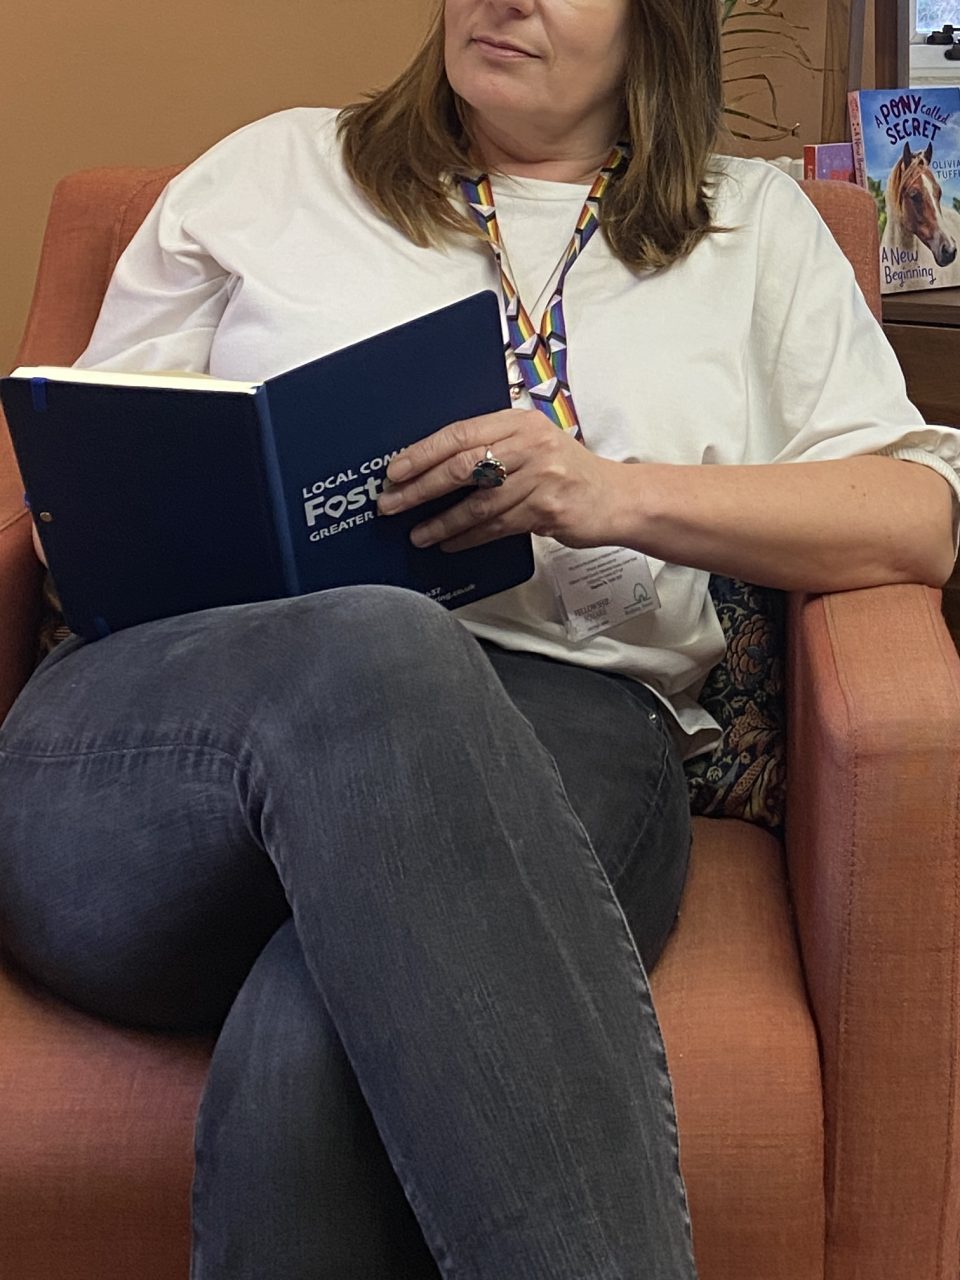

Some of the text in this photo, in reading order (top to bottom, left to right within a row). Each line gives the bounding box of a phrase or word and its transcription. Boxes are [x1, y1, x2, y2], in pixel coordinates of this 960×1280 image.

[874, 115, 883, 128] A
[879, 94, 921, 125] PONY
[920, 104, 950, 125] called
[886, 117, 941, 145] SECRET
[881, 247, 919, 266] A New
[884, 265, 937, 288] Beginning
[302, 447, 406, 499] LOCAL COM
[309, 510, 375, 542] GREATER
